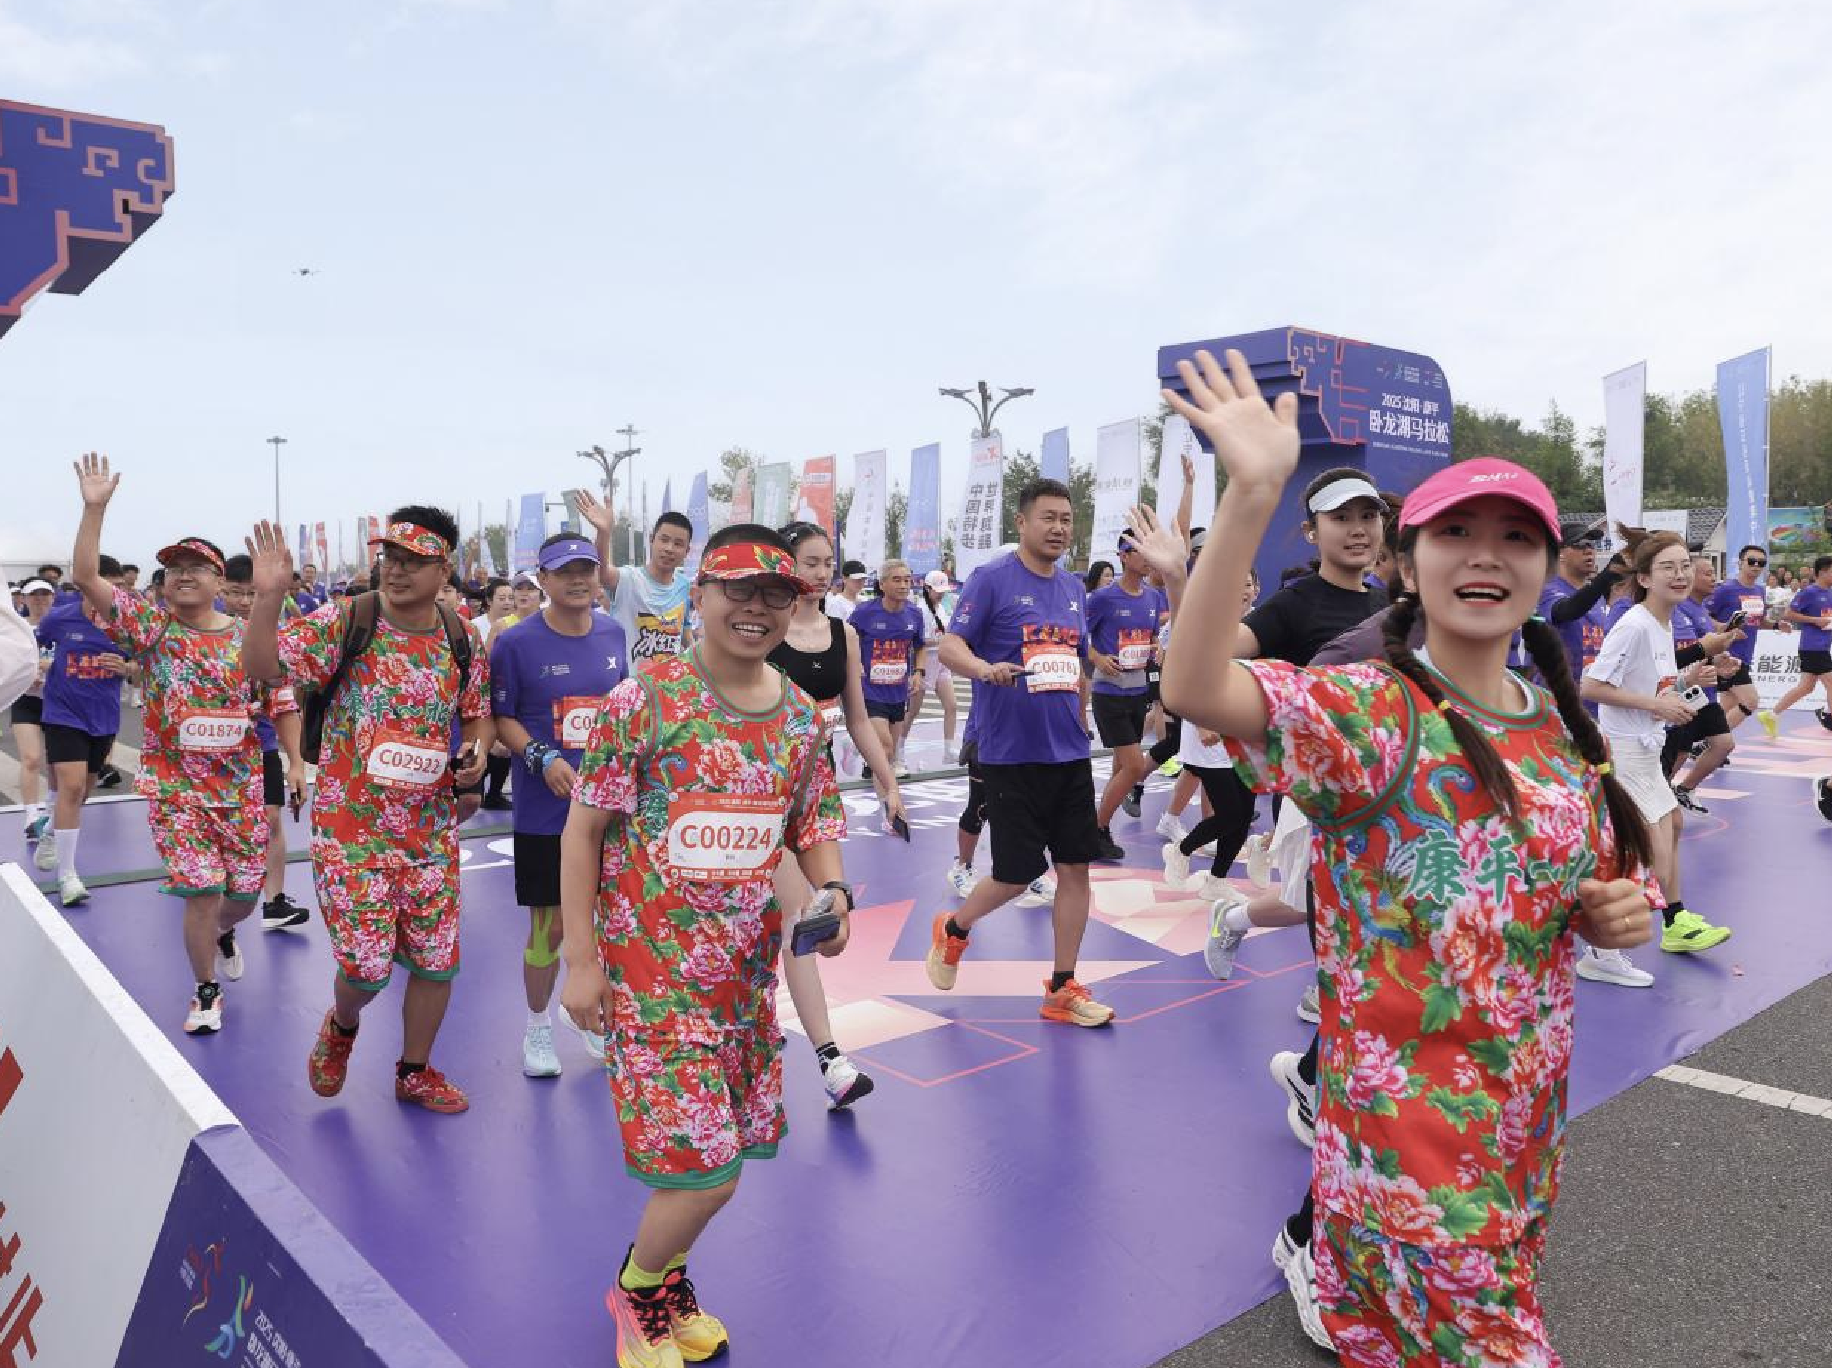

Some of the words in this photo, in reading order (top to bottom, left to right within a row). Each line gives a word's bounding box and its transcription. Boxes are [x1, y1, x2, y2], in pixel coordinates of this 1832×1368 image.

[1369, 410, 1449, 444] 卧龙湖马拉松
[186, 723, 242, 737] C01874
[379, 748, 441, 774] C02922
[680, 824, 773, 851] C00224
